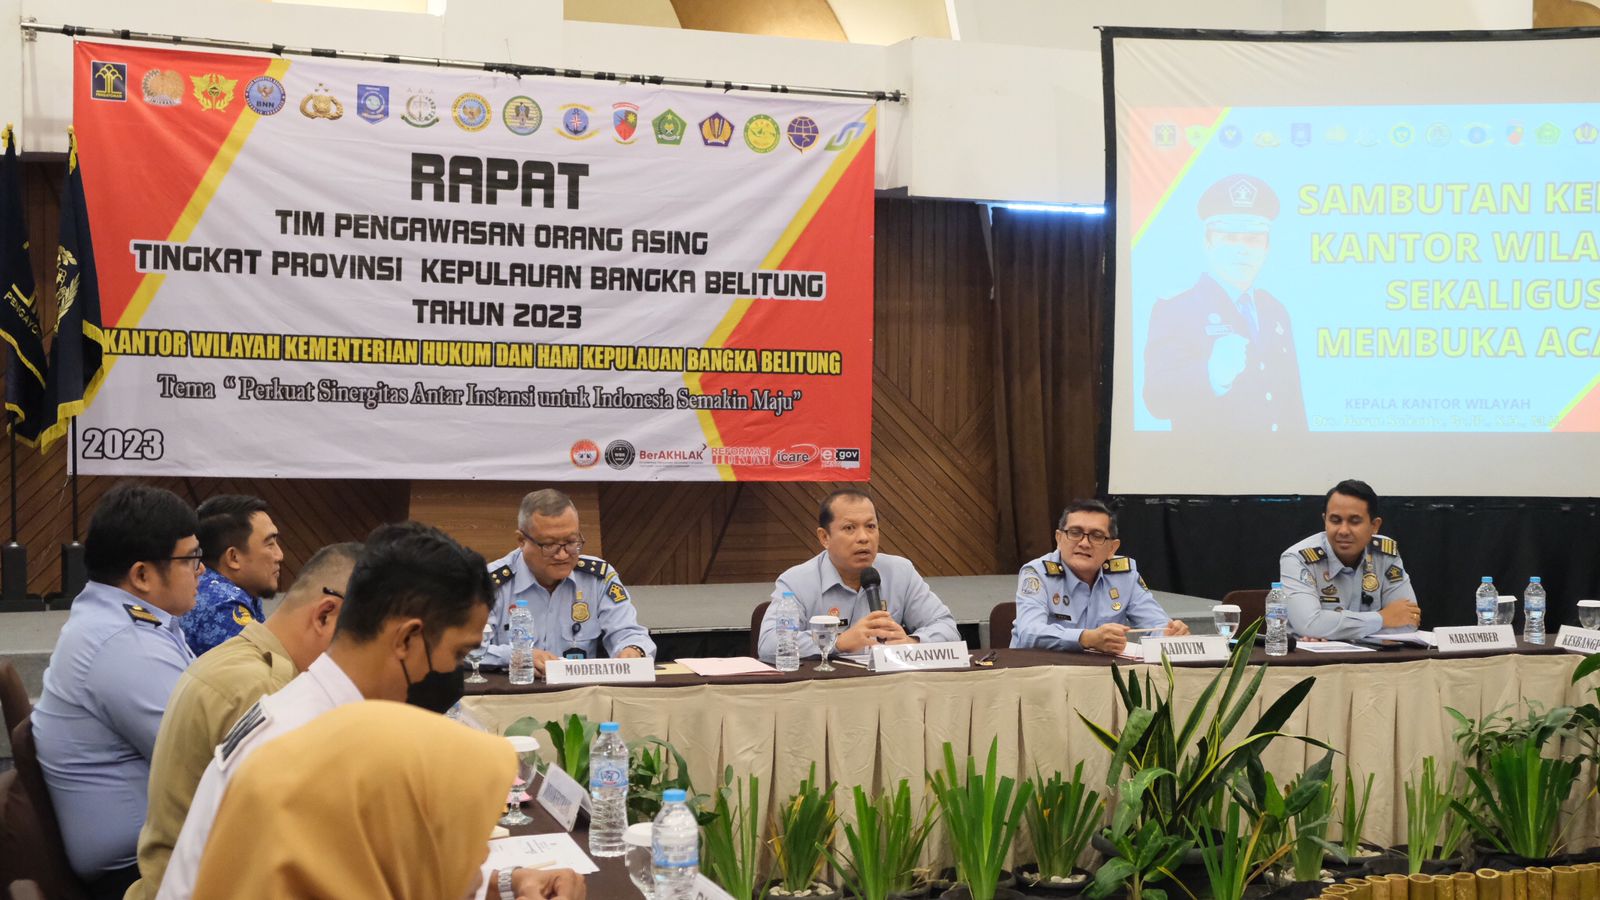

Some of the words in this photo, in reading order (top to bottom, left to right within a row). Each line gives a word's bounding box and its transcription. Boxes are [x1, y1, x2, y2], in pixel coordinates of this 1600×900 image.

[256, 100, 275, 108] BNN
[411, 152, 589, 209] RAPAT
[1297, 182, 1531, 216] SAMBUTAN
[1544, 181, 1600, 214] KE
[275, 210, 324, 237] TIM
[335, 213, 524, 247] PENGAWASAN
[535, 224, 623, 252] ORANG
[632, 229, 708, 254] ASING
[1310, 231, 1481, 264] KANTOR
[133, 243, 262, 275] TINGKAT
[272, 251, 401, 281] PROVINSI
[421, 258, 581, 289] KEPULAUAN
[591, 267, 695, 294] BANGKA
[705, 271, 823, 298] BELITUNG
[1385, 278, 1600, 311] SEKALIGUS
[412, 299, 504, 326] TAHUN
[513, 303, 582, 329] 2023
[103, 328, 188, 358] KANTOR
[190, 331, 281, 361] WILAYAH
[284, 334, 419, 366] KEMENTERIAN
[421, 340, 491, 369] HUKUM
[495, 343, 533, 370] DAN
[536, 344, 579, 371] HAM
[581, 345, 684, 373] KEPULAUAN
[686, 348, 759, 374] BANGKA
[760, 349, 843, 376] BELITUNG
[1316, 326, 1526, 358] MEMBUKA
[158, 373, 216, 400] Tema
[317, 378, 409, 409] Sinergitas
[410, 381, 464, 406] Antar
[466, 383, 535, 408] Instansi
[537, 385, 590, 409] untuk
[593, 386, 675, 410] Indonesia
[676, 388, 748, 411] Semakin
[1345, 398, 1397, 409] KEPALA
[1402, 398, 1460, 409] KANTOR
[1465, 398, 1531, 409] WILAYAH
[81, 427, 164, 460] 2023
[639, 450, 704, 460] BerAKHLAK
[711, 447, 771, 457] REFORMASI
[777, 449, 810, 463] icare
[1160, 641, 1205, 655] KADIVIM
[1448, 631, 1499, 643] NARASUMBER
[565, 662, 631, 676] MODERATOR
[884, 648, 960, 665] AKANWIL
